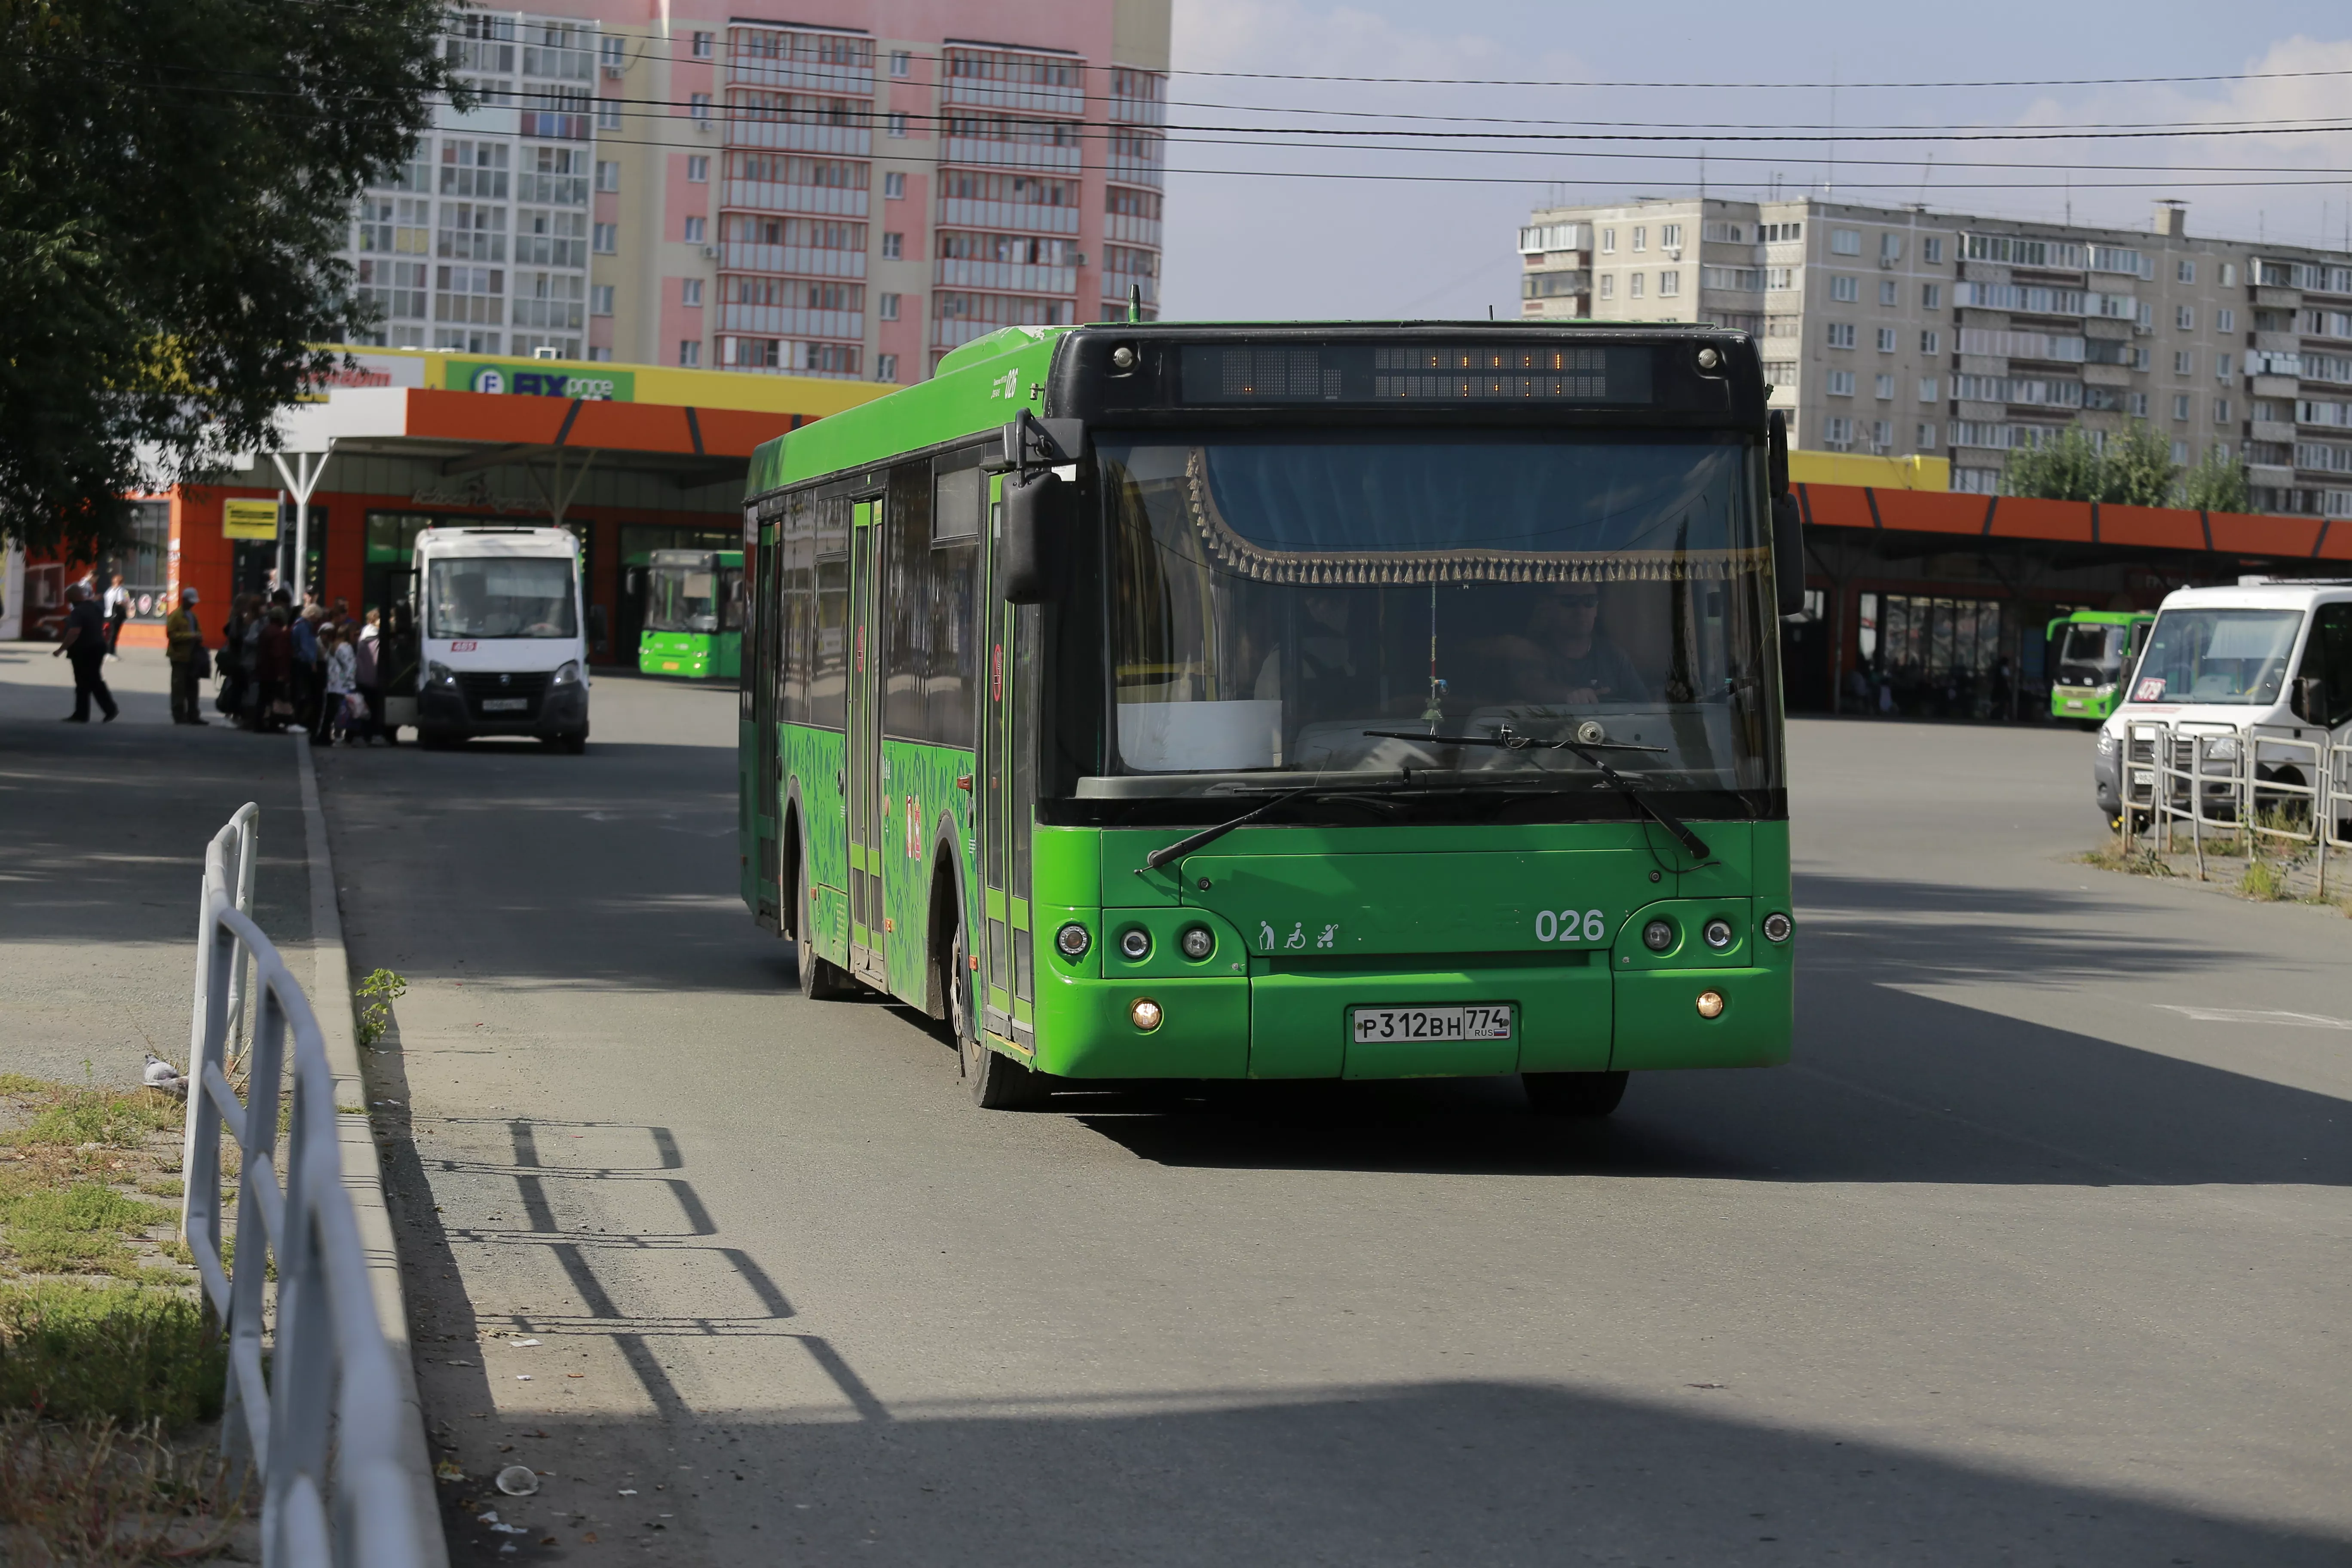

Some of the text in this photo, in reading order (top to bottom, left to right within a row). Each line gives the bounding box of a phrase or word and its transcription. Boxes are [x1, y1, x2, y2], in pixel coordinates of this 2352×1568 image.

[1005, 368, 1018, 399] 026
[1536, 910, 1604, 941] 026
[1466, 1009, 1505, 1029] 774
